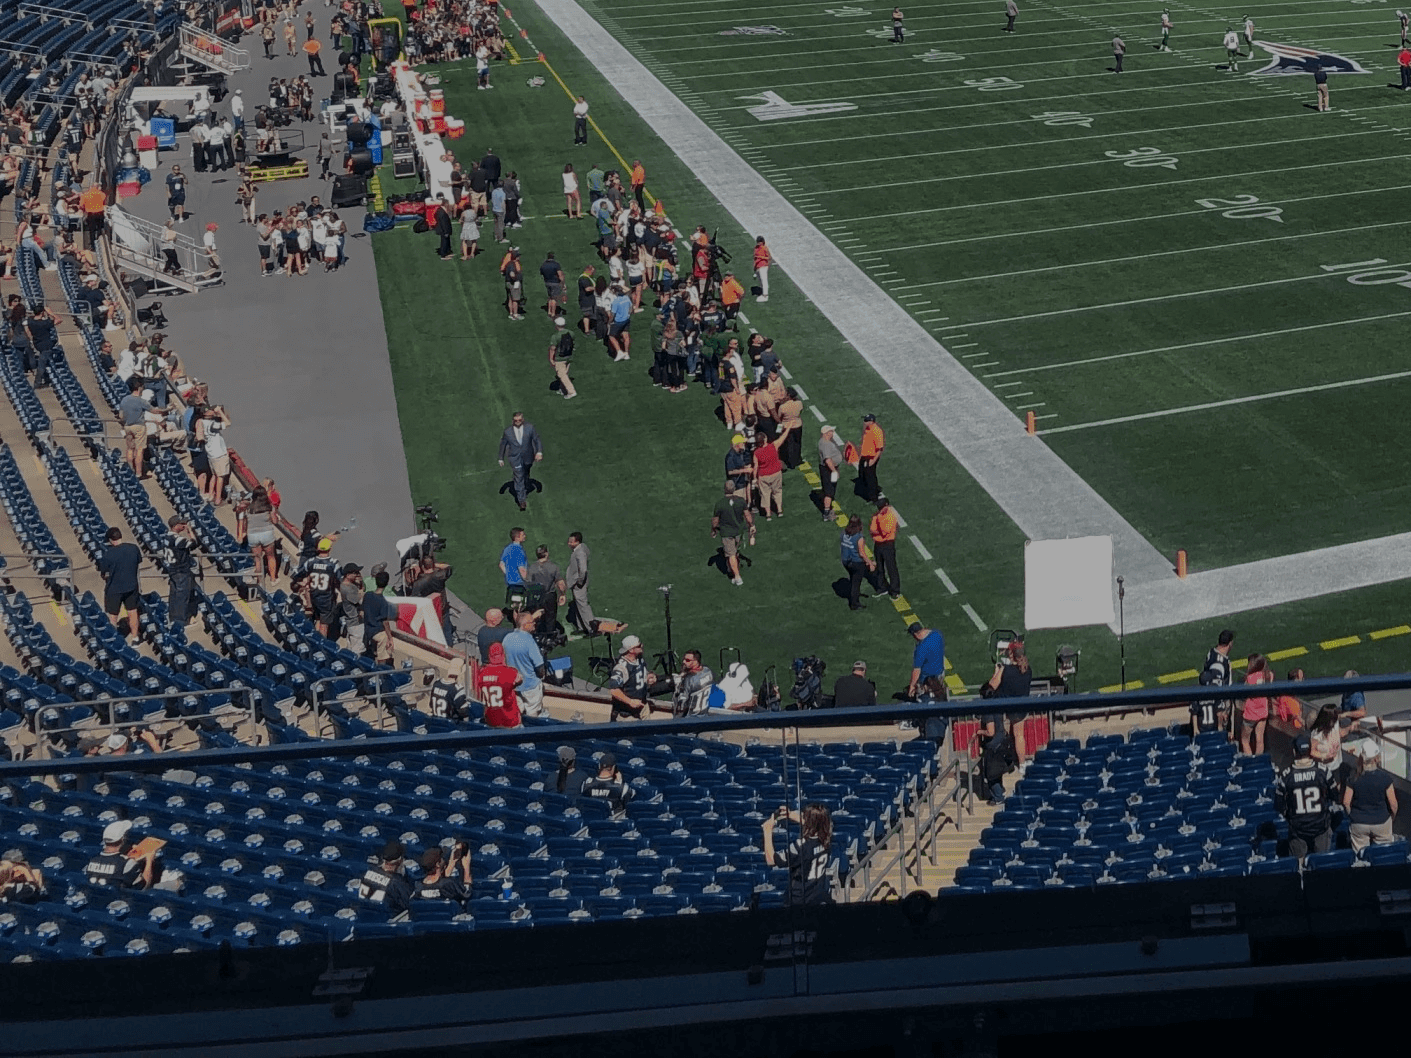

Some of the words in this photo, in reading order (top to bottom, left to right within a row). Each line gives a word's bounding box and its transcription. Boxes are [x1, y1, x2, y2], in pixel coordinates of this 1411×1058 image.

[963, 76, 1025, 93] 50
[1029, 110, 1096, 128] 40
[1104, 145, 1180, 170] 30
[1193, 194, 1286, 223] 20
[309, 572, 330, 591] 33
[432, 696, 448, 718] 12
[481, 685, 504, 708] 12
[1293, 771, 1317, 784] BRADY
[1293, 786, 1323, 815] 12
